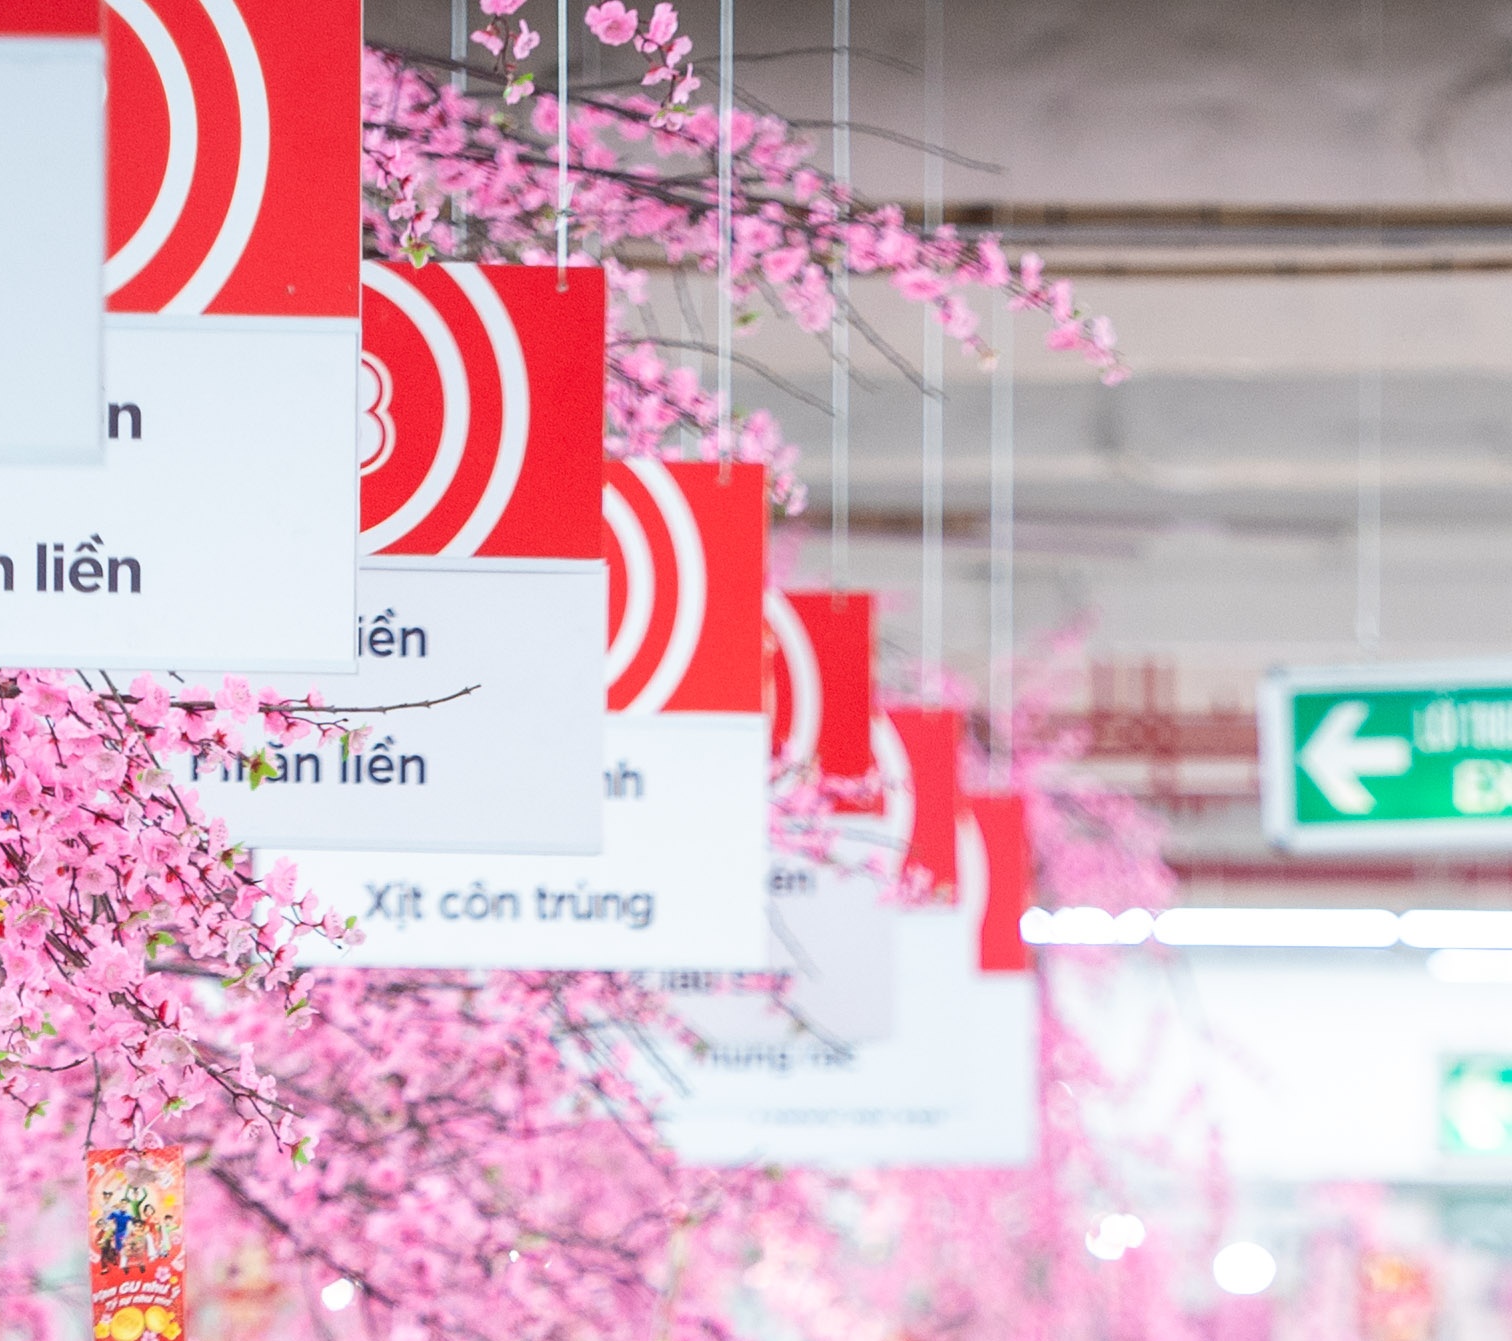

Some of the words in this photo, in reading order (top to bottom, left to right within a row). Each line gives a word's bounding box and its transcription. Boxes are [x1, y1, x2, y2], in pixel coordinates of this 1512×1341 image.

[37, 533, 143, 594] liền
[358, 608, 427, 658] iền
[363, 880, 425, 928] Xịt
[119, 1280, 141, 1295] GU
